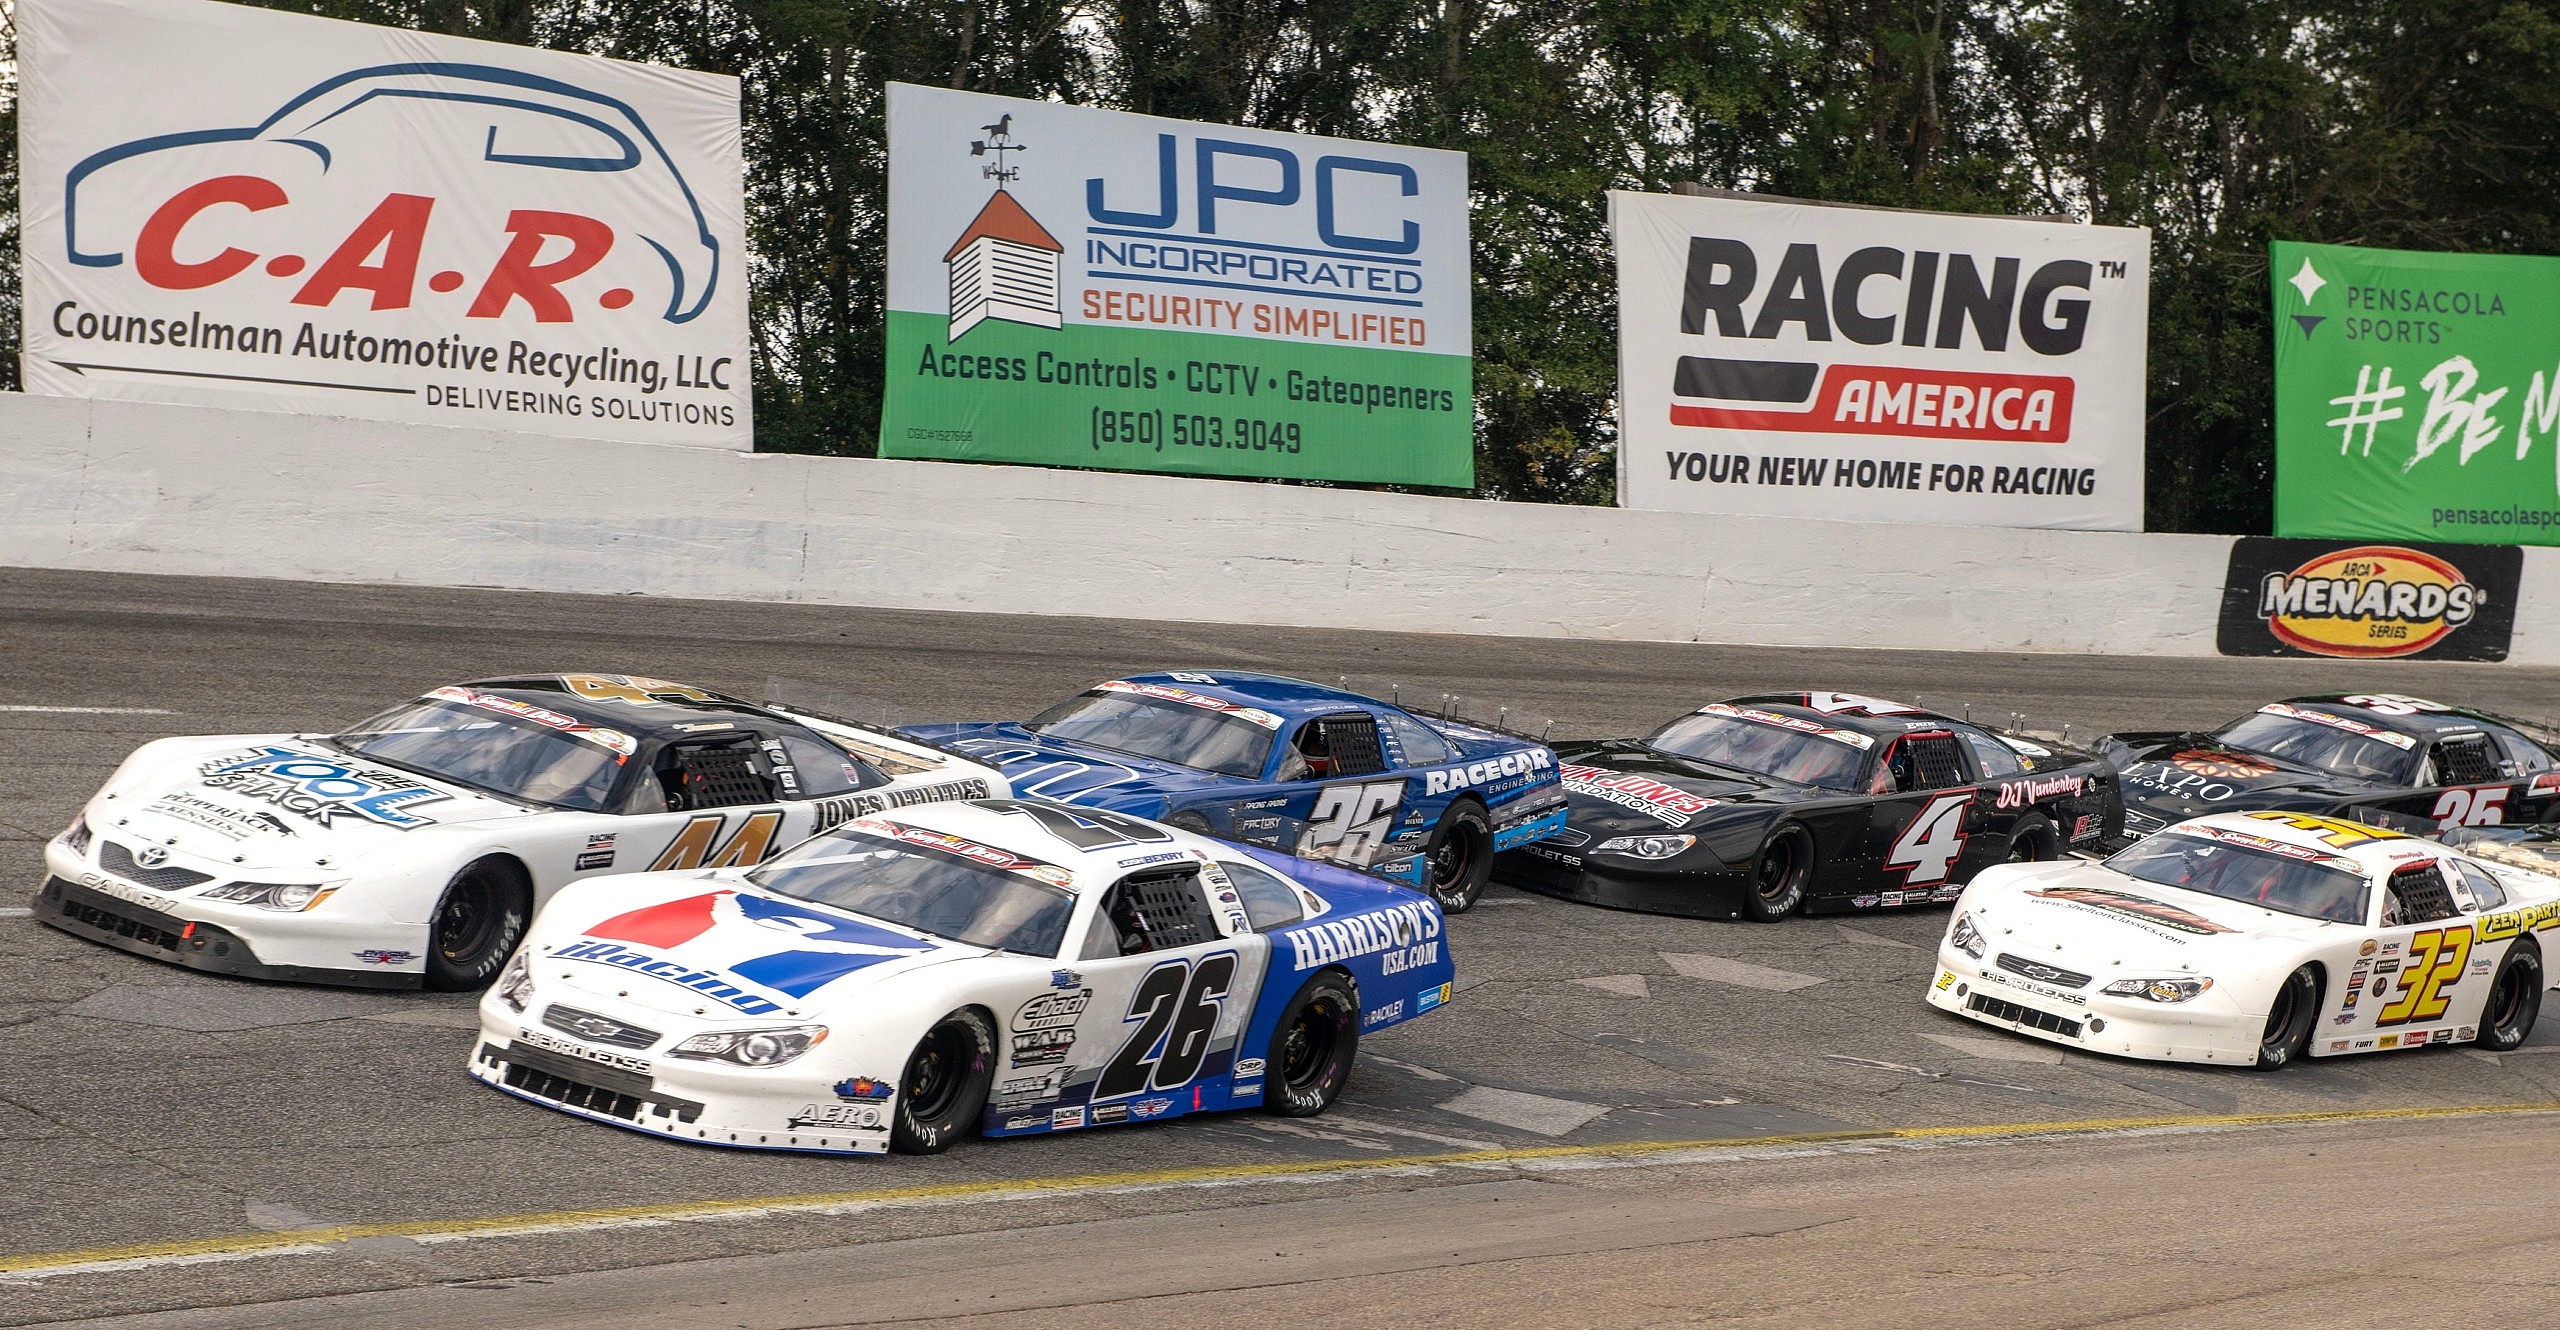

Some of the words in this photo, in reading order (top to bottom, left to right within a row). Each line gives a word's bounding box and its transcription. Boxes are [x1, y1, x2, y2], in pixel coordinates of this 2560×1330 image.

[1086, 133, 1419, 256] JPC
[135, 174, 634, 324] C.A.R.
[1087, 238, 1423, 296] INCORPORATED
[1681, 235, 2094, 357] RACING
[2347, 286, 2507, 317] PENSACOLA
[1083, 289, 1243, 332] SECURITY
[1254, 304, 1426, 347] SIMPLIFIED
[2345, 317, 2442, 345] SPORTS
[52, 300, 284, 356] Counselman
[292, 322, 500, 377] Automotive
[507, 340, 668, 395] Recycling,
[676, 354, 732, 392] LLC
[918, 342, 1028, 383] Access
[1036, 350, 1158, 391] Controls
[1186, 360, 1260, 399] CCTV
[1287, 369, 1454, 416] Gateopeners
[426, 384, 583, 418] DELIVERING
[591, 395, 735, 428] SOLUTIONS
[1834, 379, 2056, 433] AMERICA
[1091, 405, 1162, 453] (850)
[1172, 414, 1302, 456] 503.9049
[1666, 450, 1750, 486] YOUR
[1758, 456, 1828, 488] NEW
[1832, 459, 1922, 493] HOME
[1927, 463, 1984, 495] FOR
[1990, 465, 2096, 498] RACING
[2341, 562, 2372, 577] ARCA
[2264, 576, 2475, 625] MENARDS
[2368, 624, 2408, 639] SERIES
[361, 768, 424, 790] THE
[1425, 748, 1552, 798] RACECAR
[1996, 781, 2023, 809] DJ
[2023, 774, 2084, 805] Vanderley
[2118, 761, 2234, 802] EXPO
[2129, 777, 2193, 800] HOMES
[202, 771, 353, 829] SHACK
[1561, 780, 1668, 818] UNDATION
[1598, 774, 1720, 815] JONES
[166, 805, 234, 832] KENNELS
[1242, 816, 1282, 831] FACTORY
[1882, 787, 1978, 889] 4
[1144, 851, 1185, 864] BERRY
[1383, 862, 1412, 874] tilton
[79, 871, 180, 913] CAMRY
[1284, 899, 1440, 972] HARRISON'S
[2030, 898, 2187, 947] www.SheltonClassics.com
[2096, 902, 2213, 935] PERFORMANCE
[2475, 910, 2521, 945] KEEN
[1381, 940, 1439, 977] USA.COM
[2382, 942, 2401, 951] RACING
[554, 938, 786, 1016] iRacing
[1935, 971, 1958, 991] 32
[1978, 968, 2065, 1002] CHEVROLET
[2064, 991, 2087, 1007] SS
[2374, 924, 2476, 1029] 32
[1010, 988, 1092, 1034] Eibach
[1091, 949, 1240, 1103] 26
[1369, 998, 1405, 1025] RACKLEY
[518, 1026, 623, 1069] CHEVROLET
[622, 1056, 651, 1074] SS
[2354, 1040, 2375, 1049] FURY
[2410, 1033, 2428, 1044] brembo
[1001, 1075, 1048, 1096] EAGLE
[1240, 1060, 1262, 1071] DRP
[794, 1103, 881, 1128] AERO
[1054, 1108, 1083, 1119] RACING
